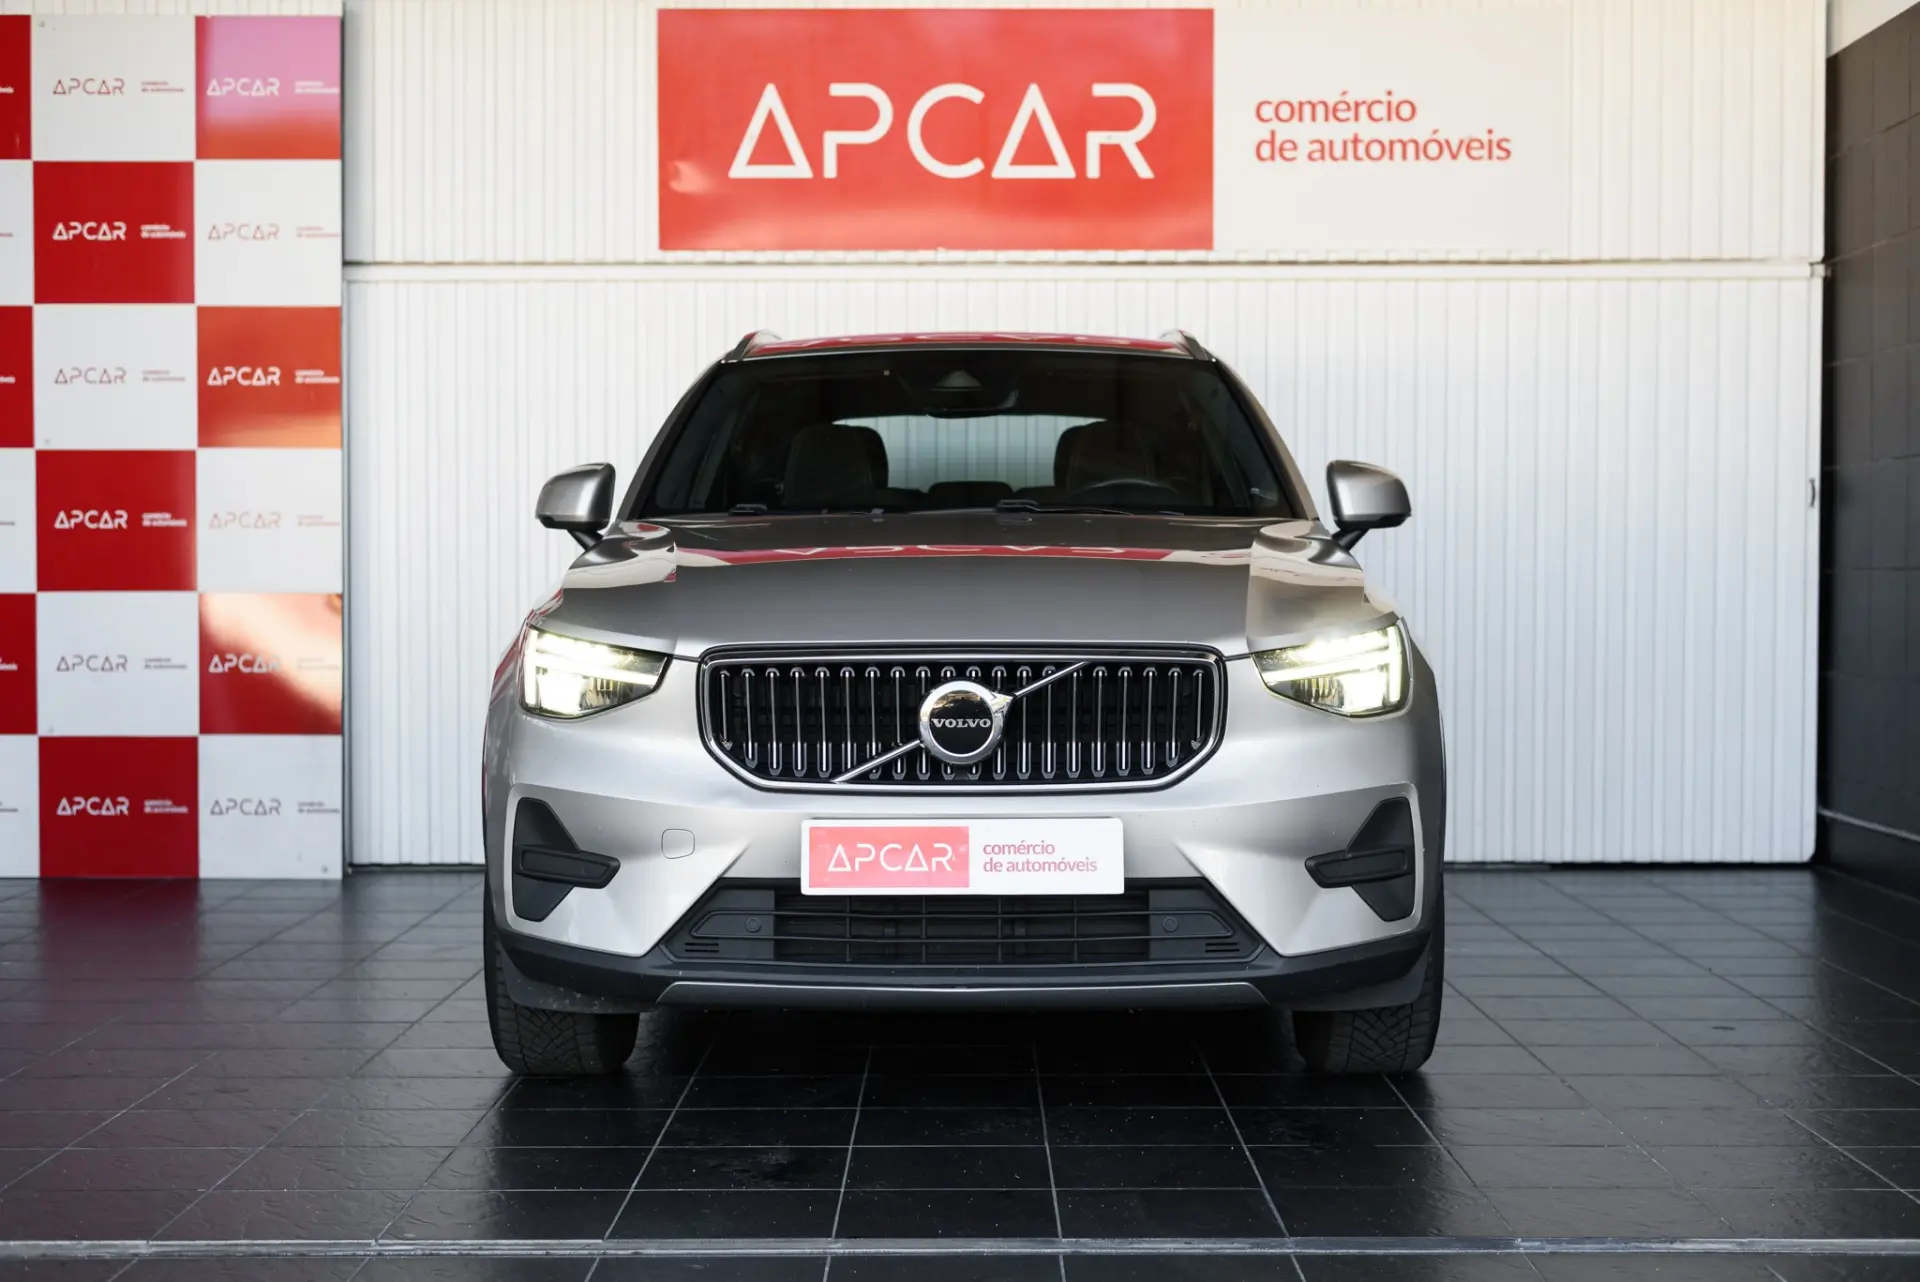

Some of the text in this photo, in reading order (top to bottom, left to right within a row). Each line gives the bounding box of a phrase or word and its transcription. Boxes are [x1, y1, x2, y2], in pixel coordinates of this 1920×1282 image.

[53, 78, 125, 96] APCAR
[206, 77, 280, 96] APCAR
[1256, 90, 1416, 122] comércio
[728, 83, 1156, 179] APCAR
[1256, 129, 1511, 161] de automóveis
[52, 222, 127, 241] APCAR
[208, 223, 280, 241] APCAR
[54, 367, 127, 385] APCAR
[207, 366, 281, 386] APCAR
[54, 510, 128, 529] APCAR
[209, 512, 281, 529] APCAR
[56, 655, 128, 672] APCAR
[931, 718, 991, 728] VOLVO
[57, 797, 129, 815] APCAR
[210, 798, 281, 816] APCAR
[983, 840, 1055, 855] comércio
[828, 843, 954, 872] APCAR
[983, 857, 1098, 873] de automóveis
